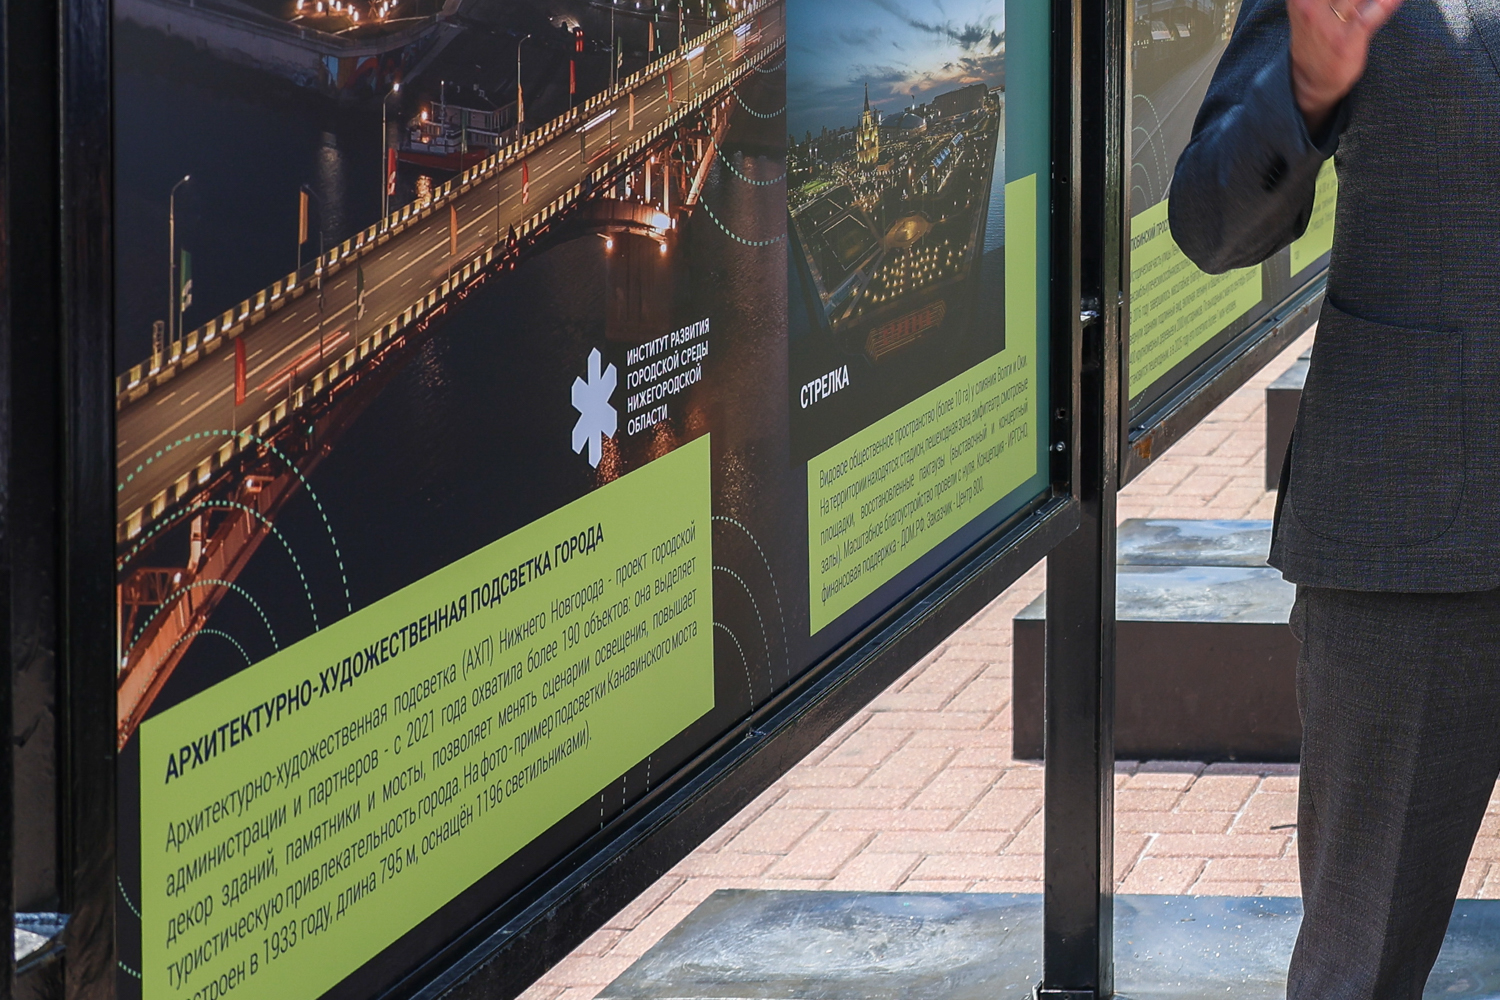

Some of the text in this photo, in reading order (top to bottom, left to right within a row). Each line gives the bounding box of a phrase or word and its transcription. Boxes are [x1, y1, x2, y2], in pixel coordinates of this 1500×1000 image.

[626, 317, 710, 367] ИНСТИТУТ РАЗВИТИЯ
[626, 340, 709, 390] ГОРОДСКОЙ СРЕДЫ
[626, 363, 702, 414] НИЖЕГОРОДСКОЙ
[626, 403, 668, 436] ОБЛАСТИ
[799, 364, 851, 410] СТРЕЛКА
[165, 522, 604, 784] АРХИТЕКТУРНО-ХУДОЖЕСТВЕННАЯ ПОДСВЕТКА ГОРОДА
[165, 519, 695, 853] Архитектурно-художественная подсветка (АХП) Нижнего Новгорода проект городской
[166, 556, 696, 897] администрации и партнеров с 2021 года охватила более 190 объектов: она выделяет
[166, 588, 697, 949] декор зданий, памятники и мосты, позволяет менять сценарии освещения, повышает
[166, 620, 697, 990] туристическую привлекательность города. На фото пример подсветки Канавинского моста
[250, 952, 258, 975] в
[263, 919, 297, 964] 1933
[301, 901, 333, 940] году,
[336, 871, 376, 921] длина
[379, 846, 402, 884] 795
[406, 844, 419, 867] м,
[421, 803, 473, 855] оснащён
[476, 779, 503, 817] 1196
[505, 719, 591, 797] светильниками).
